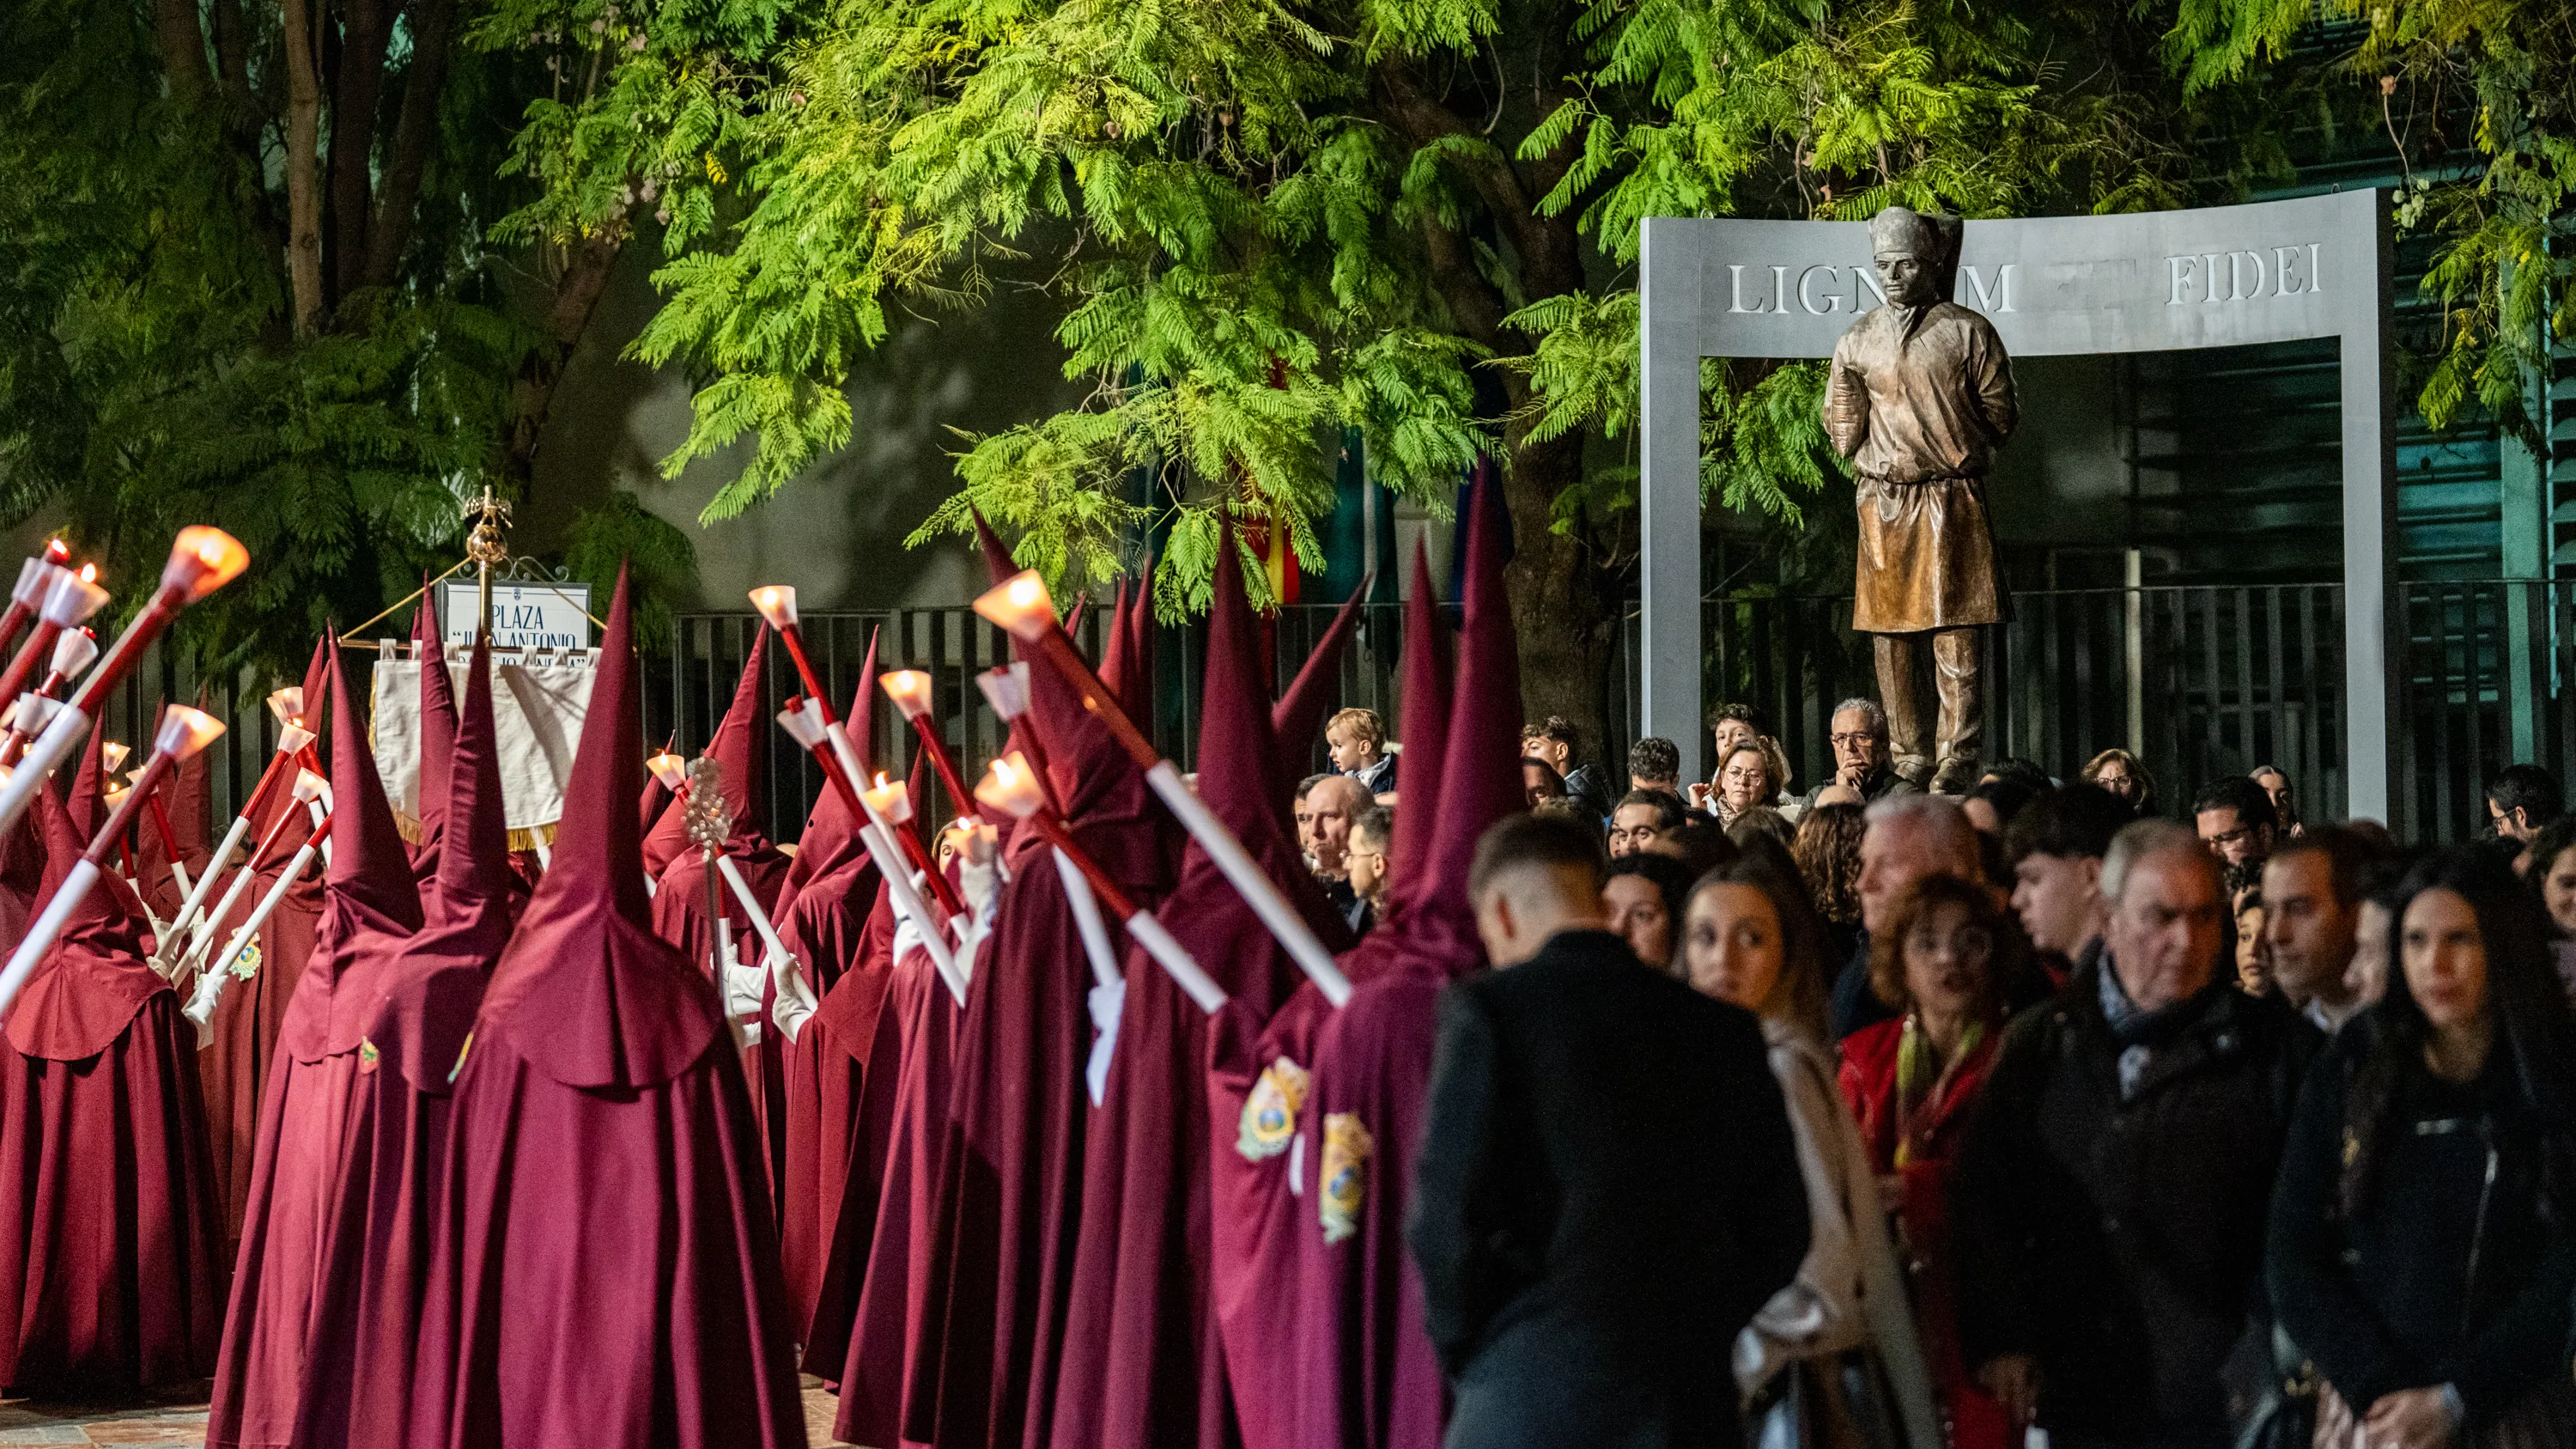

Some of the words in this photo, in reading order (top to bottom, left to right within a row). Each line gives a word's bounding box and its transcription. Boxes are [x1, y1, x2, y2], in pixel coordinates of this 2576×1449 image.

[1724, 264, 2016, 315] LIGNM
[2164, 242, 2322, 305] FIDEI
[492, 605, 544, 630] PLAZA
